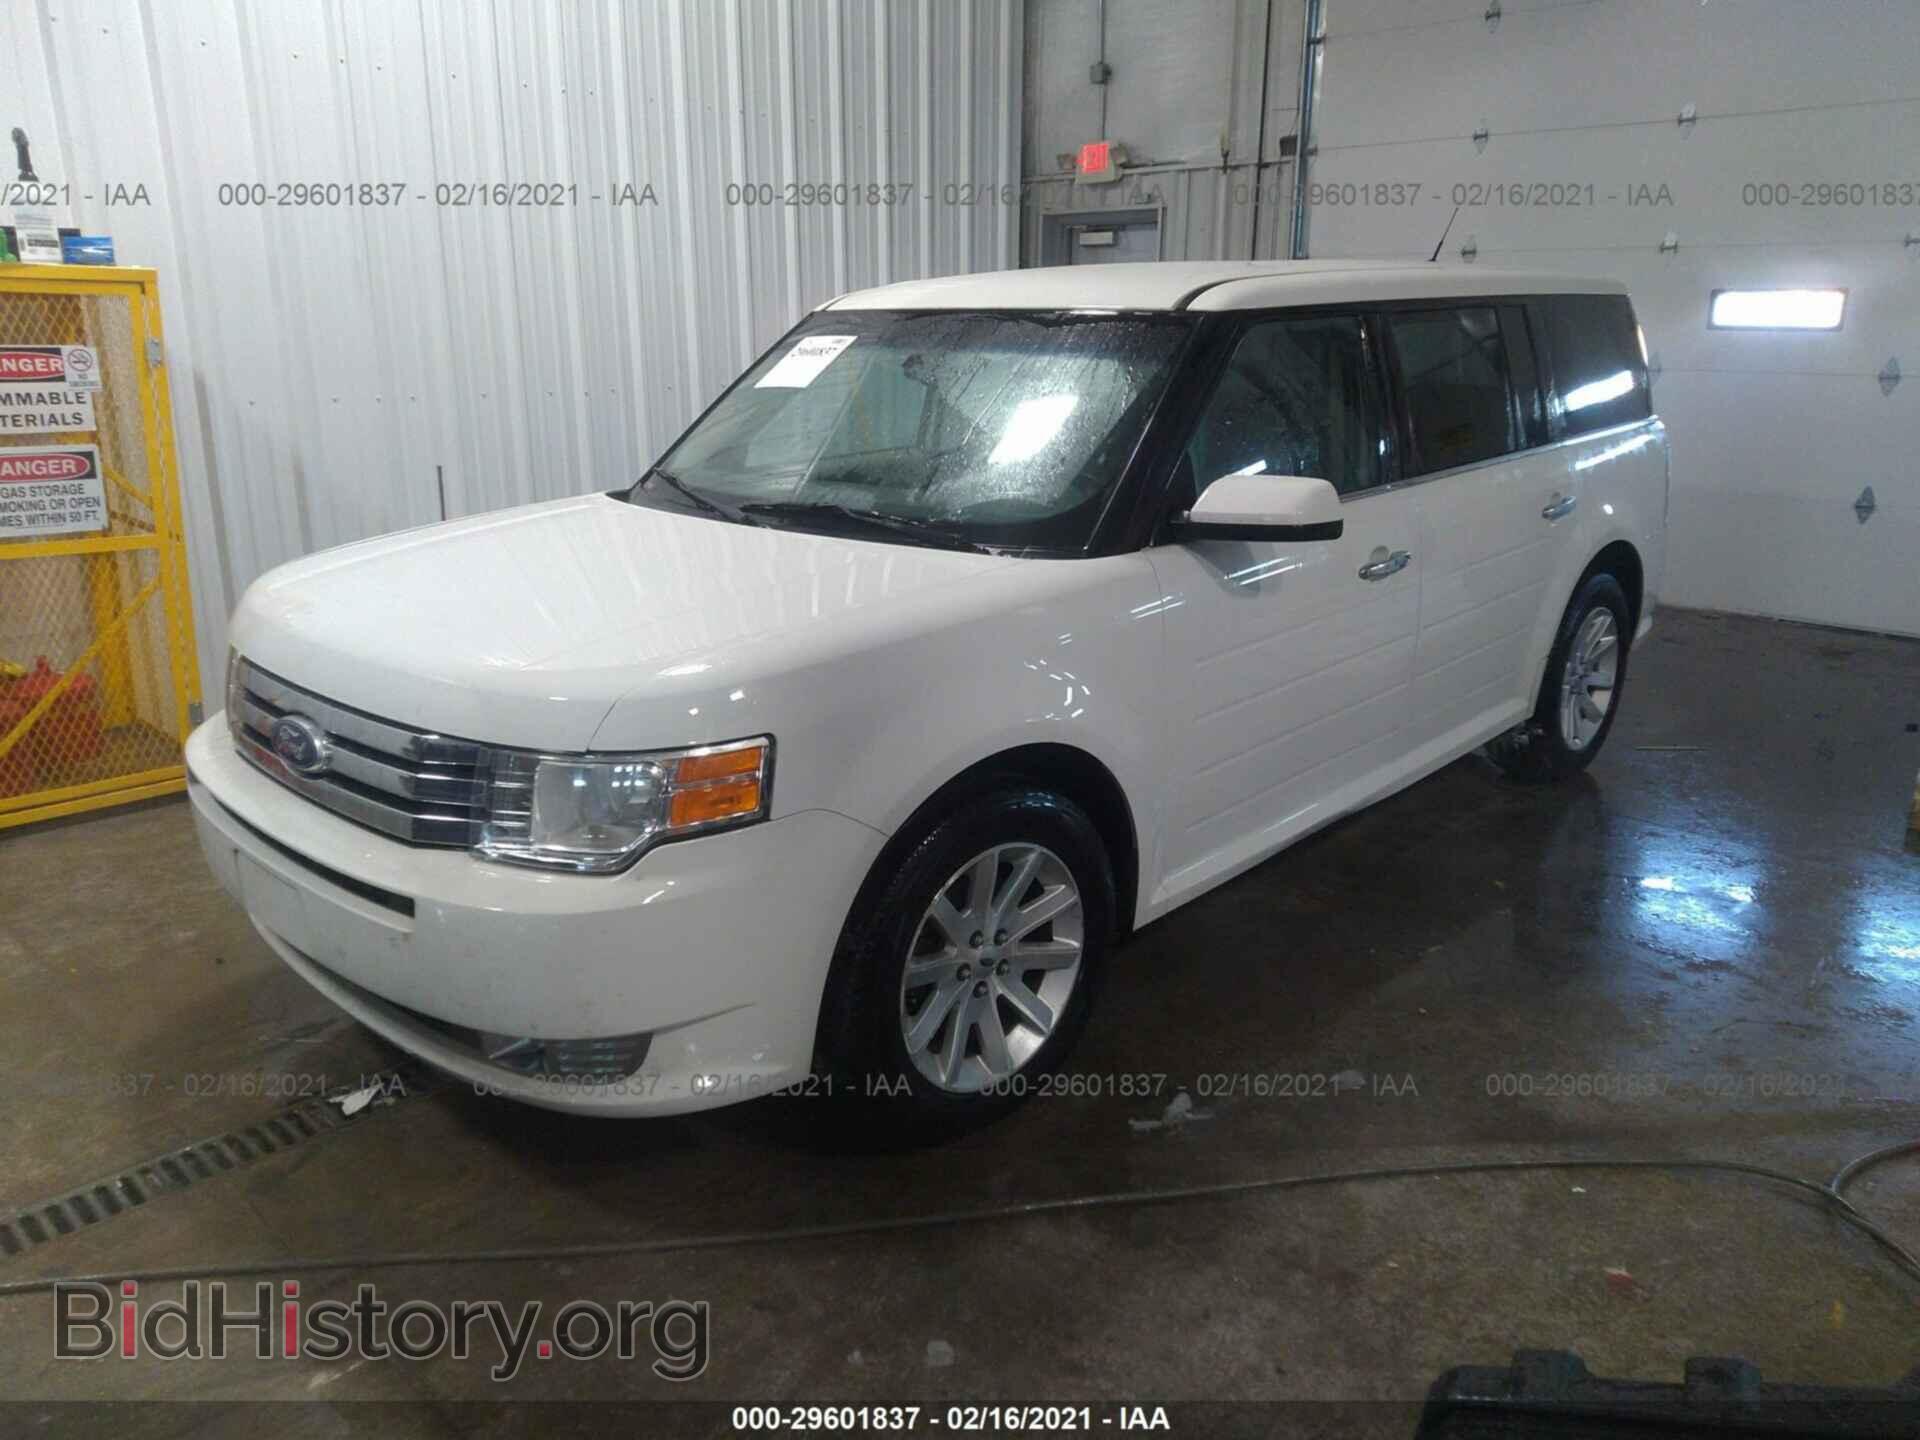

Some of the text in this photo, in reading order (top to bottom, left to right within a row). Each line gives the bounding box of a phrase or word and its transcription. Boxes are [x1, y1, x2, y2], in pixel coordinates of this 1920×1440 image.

[0, 358, 64, 372] NGER
[0, 412, 84, 428] TERIALS
[0, 483, 85, 499] GAS STORAGE
[49, 498, 65, 510] OR
[69, 496, 100, 509] OPEN
[25, 512, 66, 526] WITHIN
